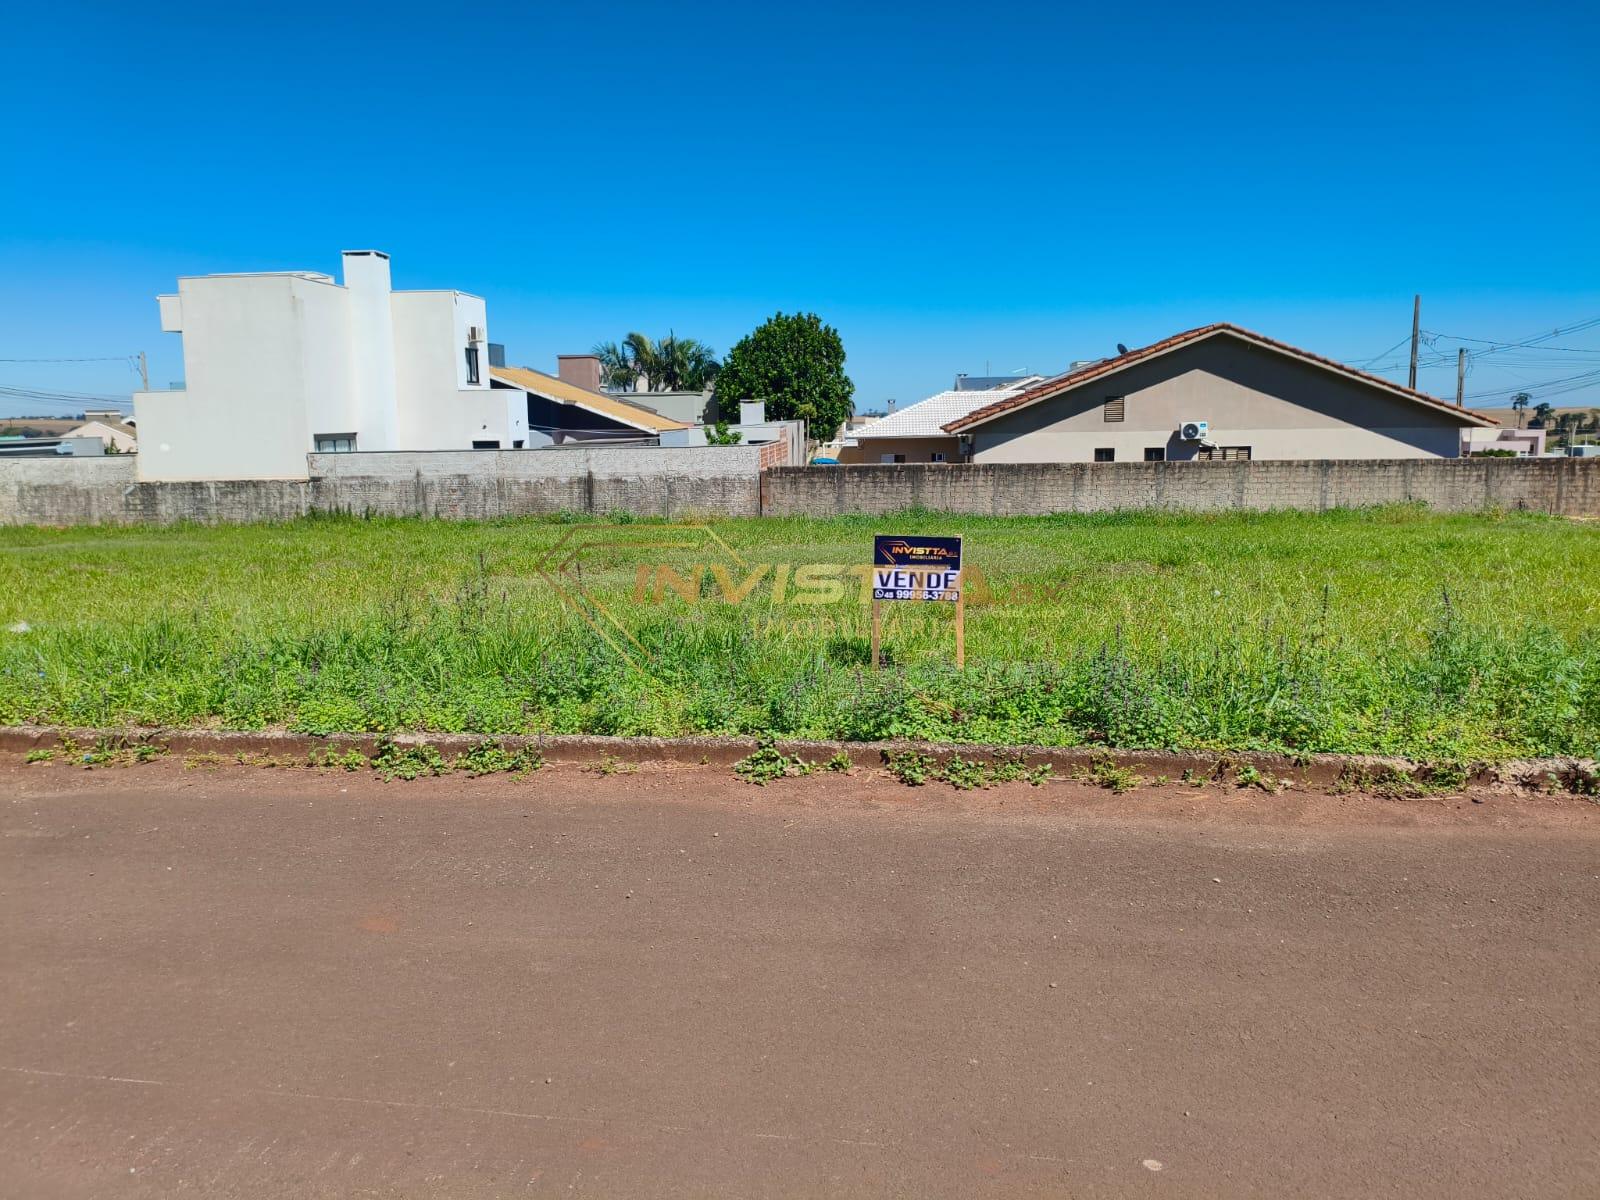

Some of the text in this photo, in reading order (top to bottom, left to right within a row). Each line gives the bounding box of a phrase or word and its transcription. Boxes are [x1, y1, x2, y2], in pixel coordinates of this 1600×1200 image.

[892, 546, 948, 555] INVISTTA
[878, 570, 957, 590] VENDE
[896, 590, 958, 601] 99956-3788
